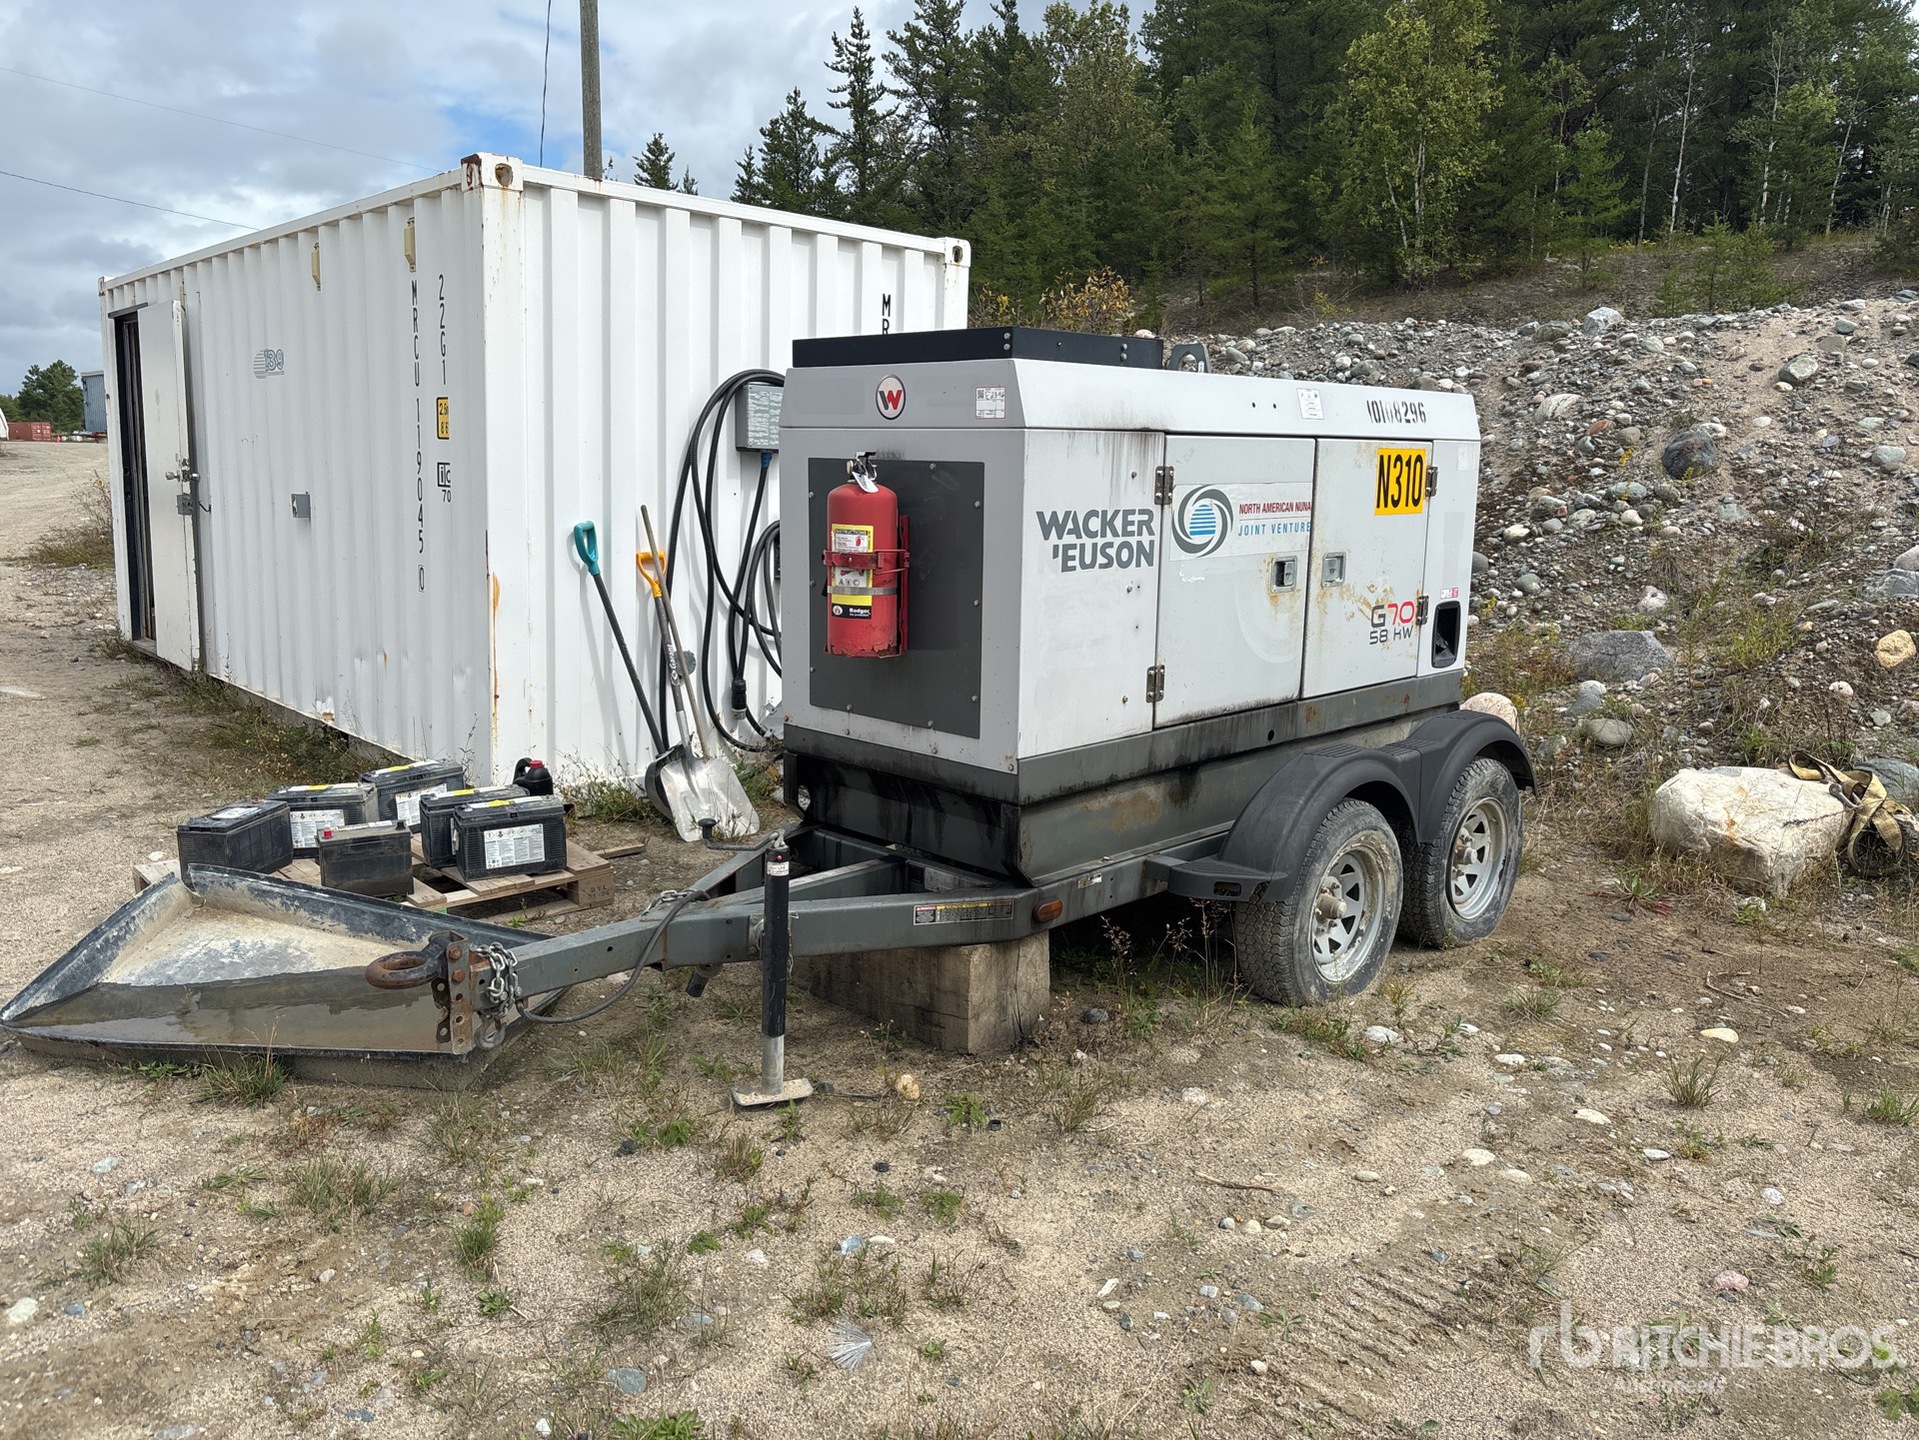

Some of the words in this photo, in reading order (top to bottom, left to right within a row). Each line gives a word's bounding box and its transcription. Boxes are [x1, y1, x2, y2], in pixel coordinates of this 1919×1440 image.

[1376, 453, 1424, 509] N310
[1238, 502, 1261, 515] NORTH
[1261, 501, 1294, 514] AMERICAN
[1036, 508, 1156, 541] WACKER
[1237, 524, 1267, 537] JOINT
[1270, 521, 1311, 535] VENTURE
[1371, 601, 1415, 628] G70
[1369, 629, 1388, 645] 58
